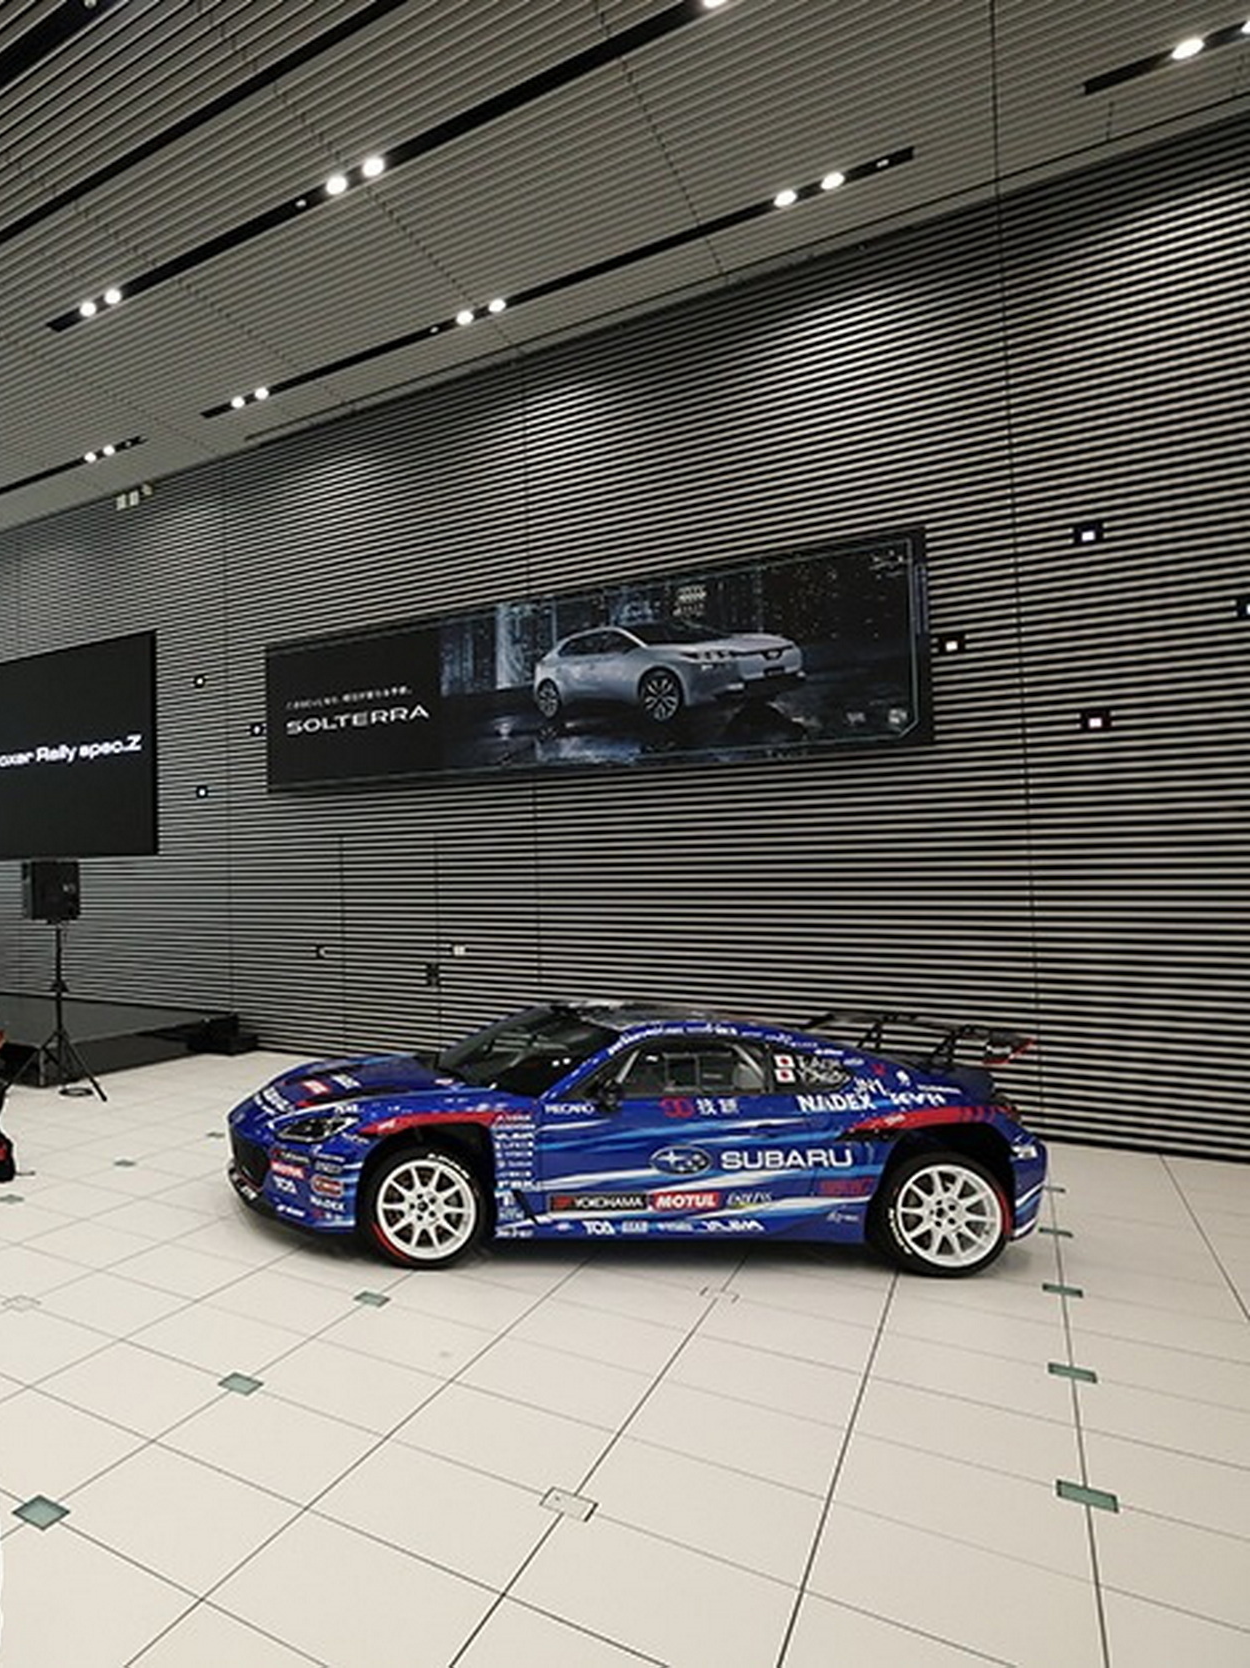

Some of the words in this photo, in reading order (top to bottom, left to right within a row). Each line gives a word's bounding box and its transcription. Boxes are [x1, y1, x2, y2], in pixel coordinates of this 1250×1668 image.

[286, 704, 431, 736] SOLTERRA
[36, 744, 77, 764] Rally
[79, 734, 142, 760] spec.Z
[796, 1093, 877, 1113] NADEX
[720, 1149, 854, 1170] SUBARU
[574, 1196, 644, 1209] YOKOHAMA
[656, 1193, 718, 1209] MOTUL
